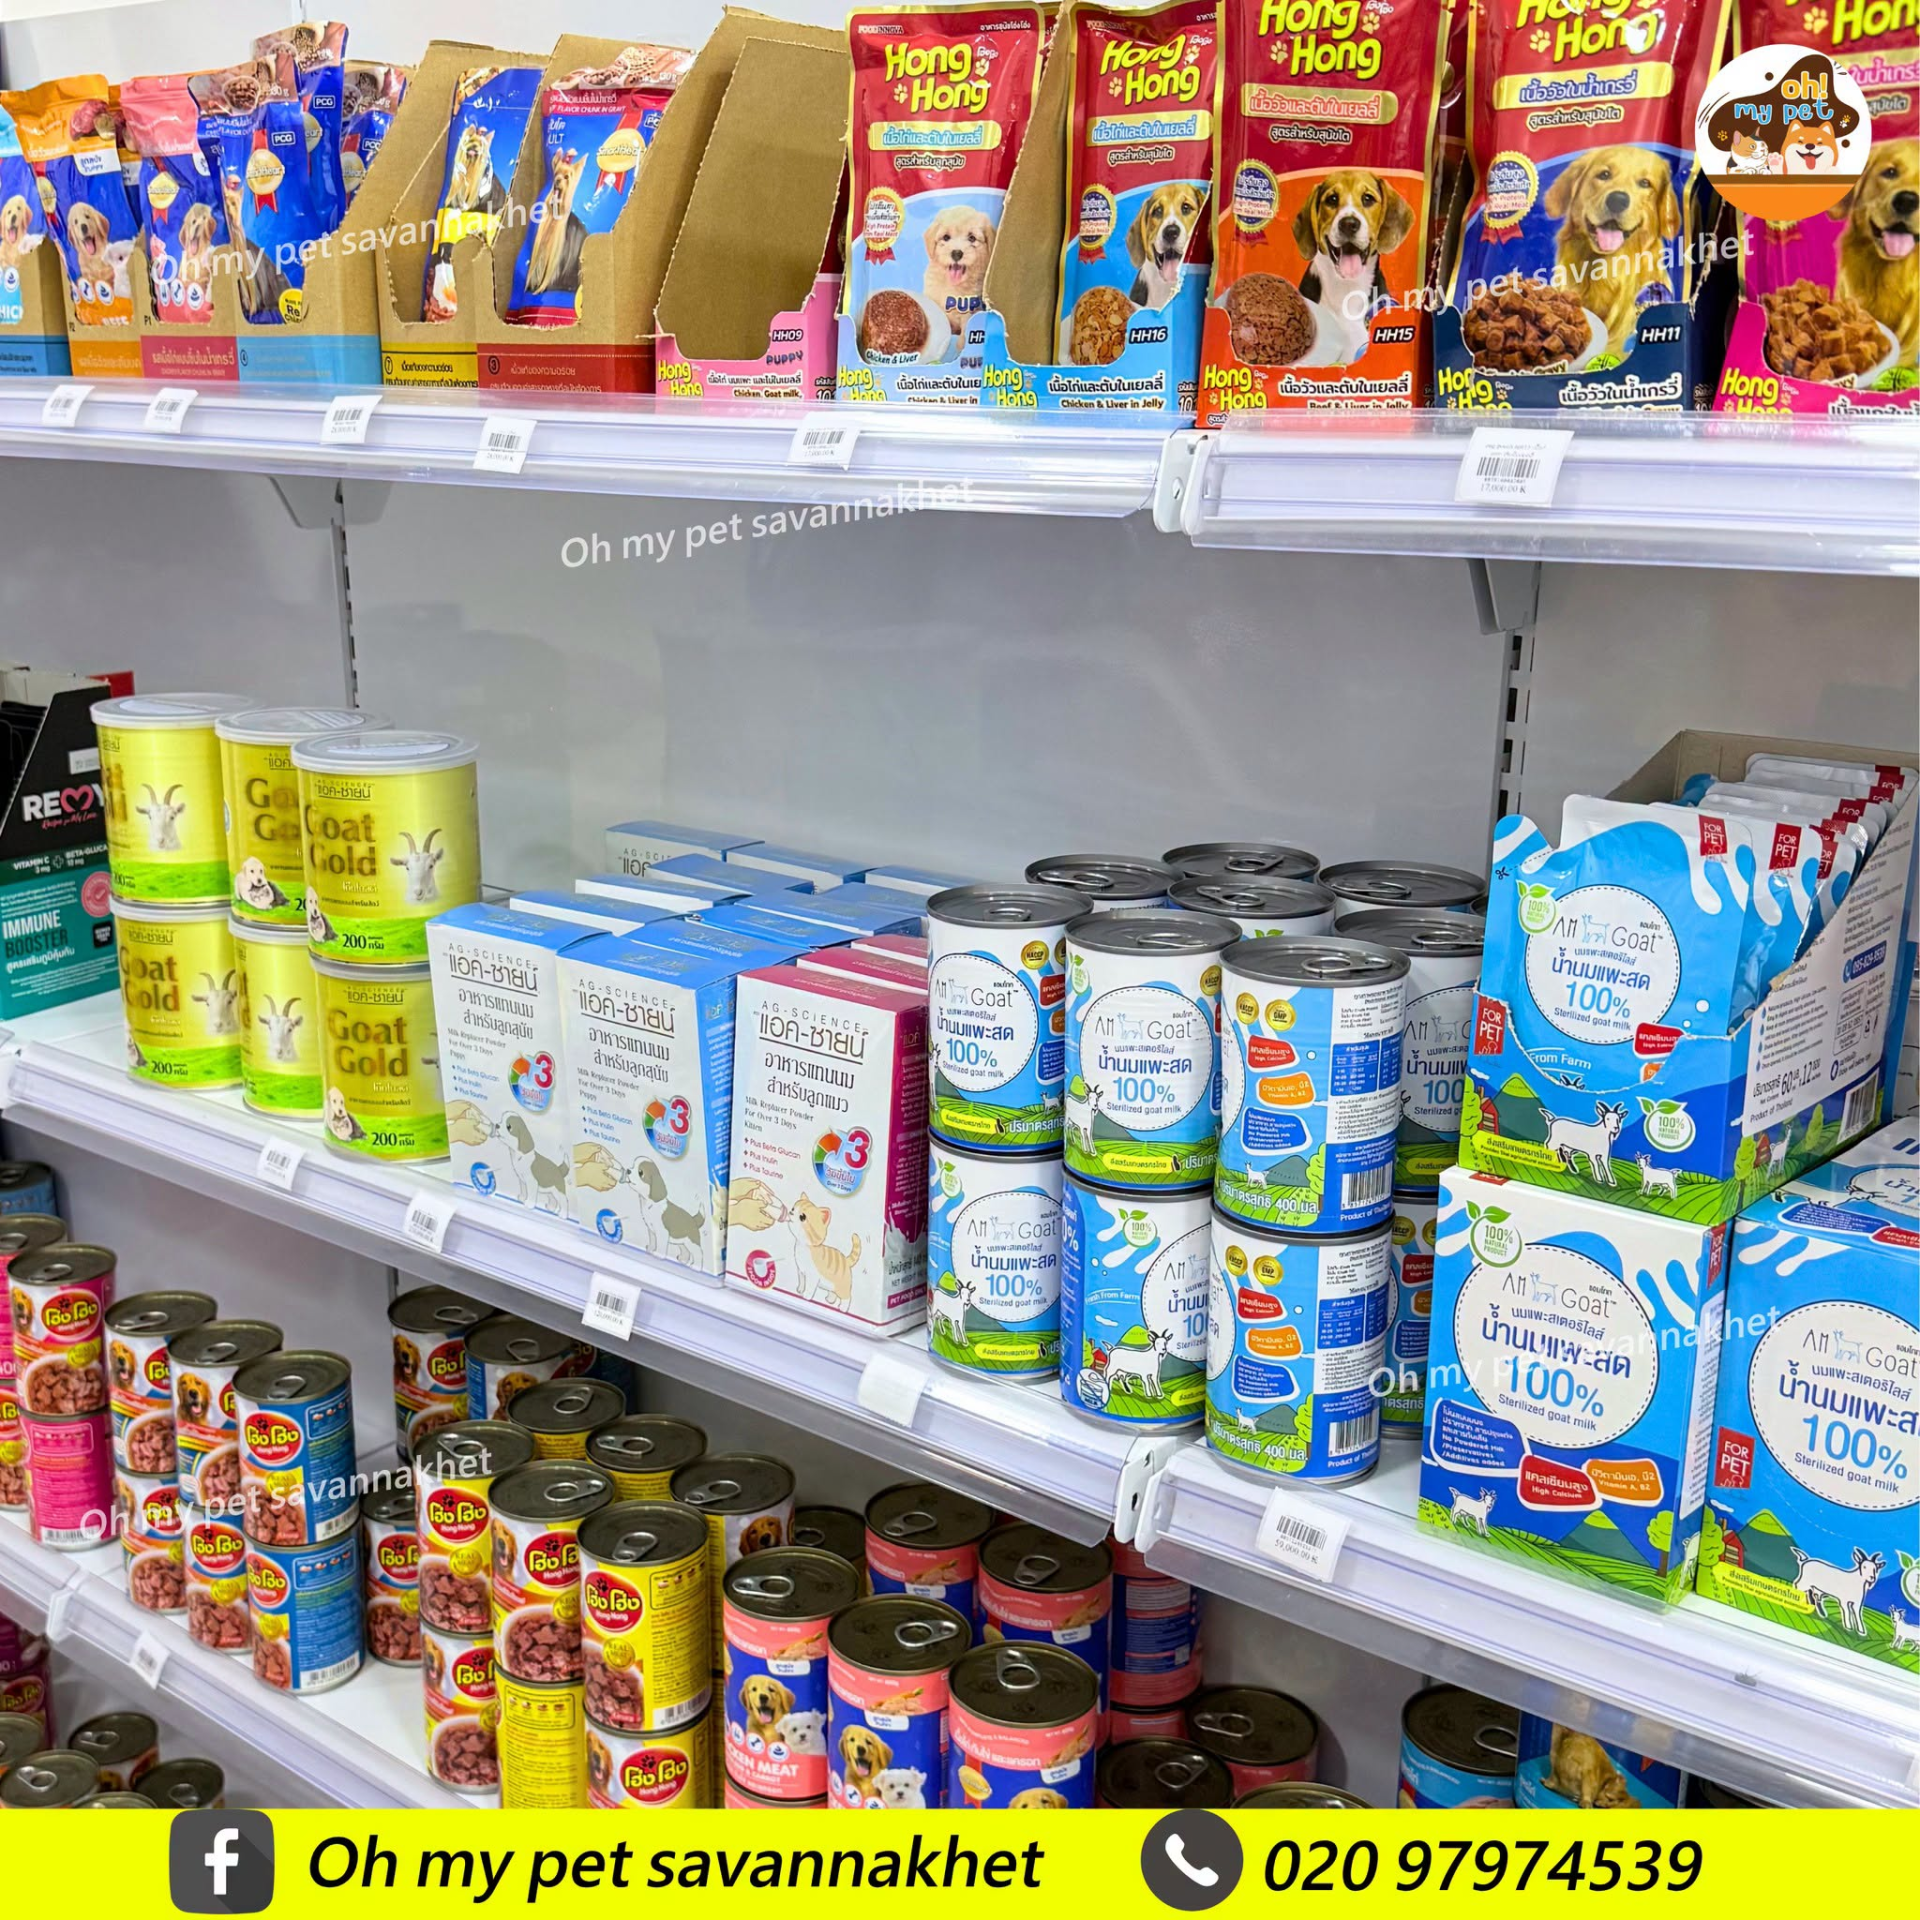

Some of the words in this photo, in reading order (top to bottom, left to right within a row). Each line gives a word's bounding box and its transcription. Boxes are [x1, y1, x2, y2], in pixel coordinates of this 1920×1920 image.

[1258, 0, 1361, 40] Hong
[1553, 9, 1666, 63] Hong
[885, 43, 972, 82] Hong
[1101, 34, 1186, 75] Hong
[1290, 34, 1382, 79] Hong
[911, 77, 992, 114] Hong
[1125, 65, 1201, 105] Hong
[1519, 69, 1638, 104] เนื้อวัวในน้ำเกรวี่
[316, 97, 333, 107] PCG
[1249, 88, 1381, 120] เนื้อวัวและตับในเยลลี่
[275, 133, 292, 143] PCG
[883, 126, 983, 146] เนื้อไก่และตับในเยลลี่
[1092, 115, 1197, 142] เนื้อไก่และตับในเยลลี่
[772, 330, 803, 342] HH09
[1130, 327, 1168, 343] HH16
[1373, 327, 1415, 343] HH15
[1641, 327, 1681, 343] HH11
[659, 361, 691, 382] Hong
[766, 351, 803, 365] PUPPY
[838, 365, 874, 389] Hong
[983, 364, 1023, 391] Hong
[1048, 371, 1164, 394] เนื้อไก่และตับในเยลลี่
[1204, 364, 1252, 392] Hong
[1278, 372, 1412, 395] เนื้อวัวและตับในเยลลี่
[1559, 373, 1682, 404] เนื้อวัวในน้ำเกรวี่
[1721, 368, 1780, 399] Hong
[1220, 389, 1267, 410] Hong
[1519, 485, 1526, 493] K
[1703, 822, 1722, 835] FOR
[1703, 833, 1725, 846] PET
[1778, 833, 1797, 845] FOR
[1775, 844, 1798, 859] PET
[1528, 899, 1551, 913] 100%
[3, 910, 61, 940] IMMUNE
[5, 929, 69, 960] BOOSTER
[1611, 925, 1657, 953] Goat
[119, 945, 178, 982] Goat
[449, 943, 532, 969] AG-SCIENCE
[1552, 947, 1651, 991] น้ำนมแพะสด
[449, 953, 539, 991] แอค-ซายน์
[124, 982, 180, 1012] Gold
[458, 988, 534, 1019] อาหารแทนนม
[579, 979, 669, 1010] AG-SCIENCE
[1566, 981, 1631, 1019] 100%
[463, 1009, 534, 1040] สำหรับลูกสุนัข
[579, 990, 676, 1033] แอค-ซายน์
[762, 1000, 862, 1033] AG-SCIENCE
[937, 1007, 1014, 1041] น้ำนมแพะสด
[1482, 1008, 1502, 1024] FOR
[1554, 1007, 1590, 1024] Sterilized
[1592, 1015, 1611, 1030] goat
[1612, 1018, 1631, 1032] milk
[328, 1008, 407, 1045] Goat
[759, 1013, 869, 1059] แอค-ซายน์
[1147, 1020, 1192, 1040] Goat
[1479, 1022, 1503, 1043] PET
[589, 1028, 670, 1061] อาหารแทนนม
[946, 1038, 998, 1067] 100%
[335, 1045, 409, 1077] Gold
[594, 1049, 670, 1083] สำหรับลูกสุนัข
[765, 1052, 855, 1090] อาหารแทนนม
[1099, 1045, 1192, 1074] น้ำนมแพะสด
[1560, 1053, 1592, 1070] Farm
[767, 1075, 849, 1114] สำหรับลูกแมว
[1113, 1077, 1176, 1103] 100%
[1781, 1071, 1792, 1097] 60
[669, 1096, 691, 1134] 3
[744, 1108, 756, 1118] For
[757, 1112, 773, 1122] Over
[781, 1118, 797, 1130] Days
[745, 1096, 758, 1107] Milk
[760, 1100, 788, 1115] Replacer
[789, 1107, 814, 1122] Powder
[1106, 1101, 1143, 1114] Sterilized
[1144, 1105, 1163, 1115] goat
[1164, 1103, 1182, 1114] milk
[1658, 1116, 1685, 1130] 100%
[844, 1130, 870, 1170] 3
[1018, 1220, 1057, 1239] Goat
[1485, 1224, 1514, 1245] 100%
[1484, 1238, 1509, 1250] NATURAL
[1484, 1244, 1508, 1257] PRODUCT
[971, 1245, 1057, 1271] น้ำนมแพะสด
[985, 1274, 1043, 1297] 100%
[1502, 1272, 1527, 1297] AM
[1561, 1287, 1610, 1318] Goat
[979, 1296, 1014, 1307] Sterilized
[1015, 1298, 1032, 1308] goat
[1033, 1297, 1048, 1306] milk
[1511, 1306, 1606, 1341] นมแพะสเตอริไลส์
[1482, 1304, 1631, 1379] น้ำนมแพะสด
[1802, 1329, 1829, 1354] AM
[1866, 1346, 1918, 1379] Goat
[1504, 1355, 1605, 1417] 100%
[1811, 1364, 1913, 1402] นมแพะสเตอริไลส์
[1499, 1394, 1545, 1418] Sterilized
[1547, 1404, 1571, 1424] goat
[1574, 1412, 1597, 1432] milk
[1725, 1440, 1749, 1459] FOR
[1802, 1414, 1908, 1479] 100%
[1720, 1454, 1750, 1477] PET
[1794, 1452, 1845, 1478] Sterilized
[1847, 1466, 1872, 1487] goat
[1874, 1474, 1900, 1494] milk
[1525, 1470, 1589, 1494] แคลเซียมสูง
[1532, 1486, 1550, 1497] High
[1552, 1489, 1583, 1499] Calcium
[440, 1524, 457, 1533] Hong
[458, 1522, 476, 1532] Hong
[595, 1610, 611, 1621] Hong
[611, 1610, 629, 1621] Hong
[639, 1785, 657, 1795] Hong
[658, 1780, 678, 1792] Hong
